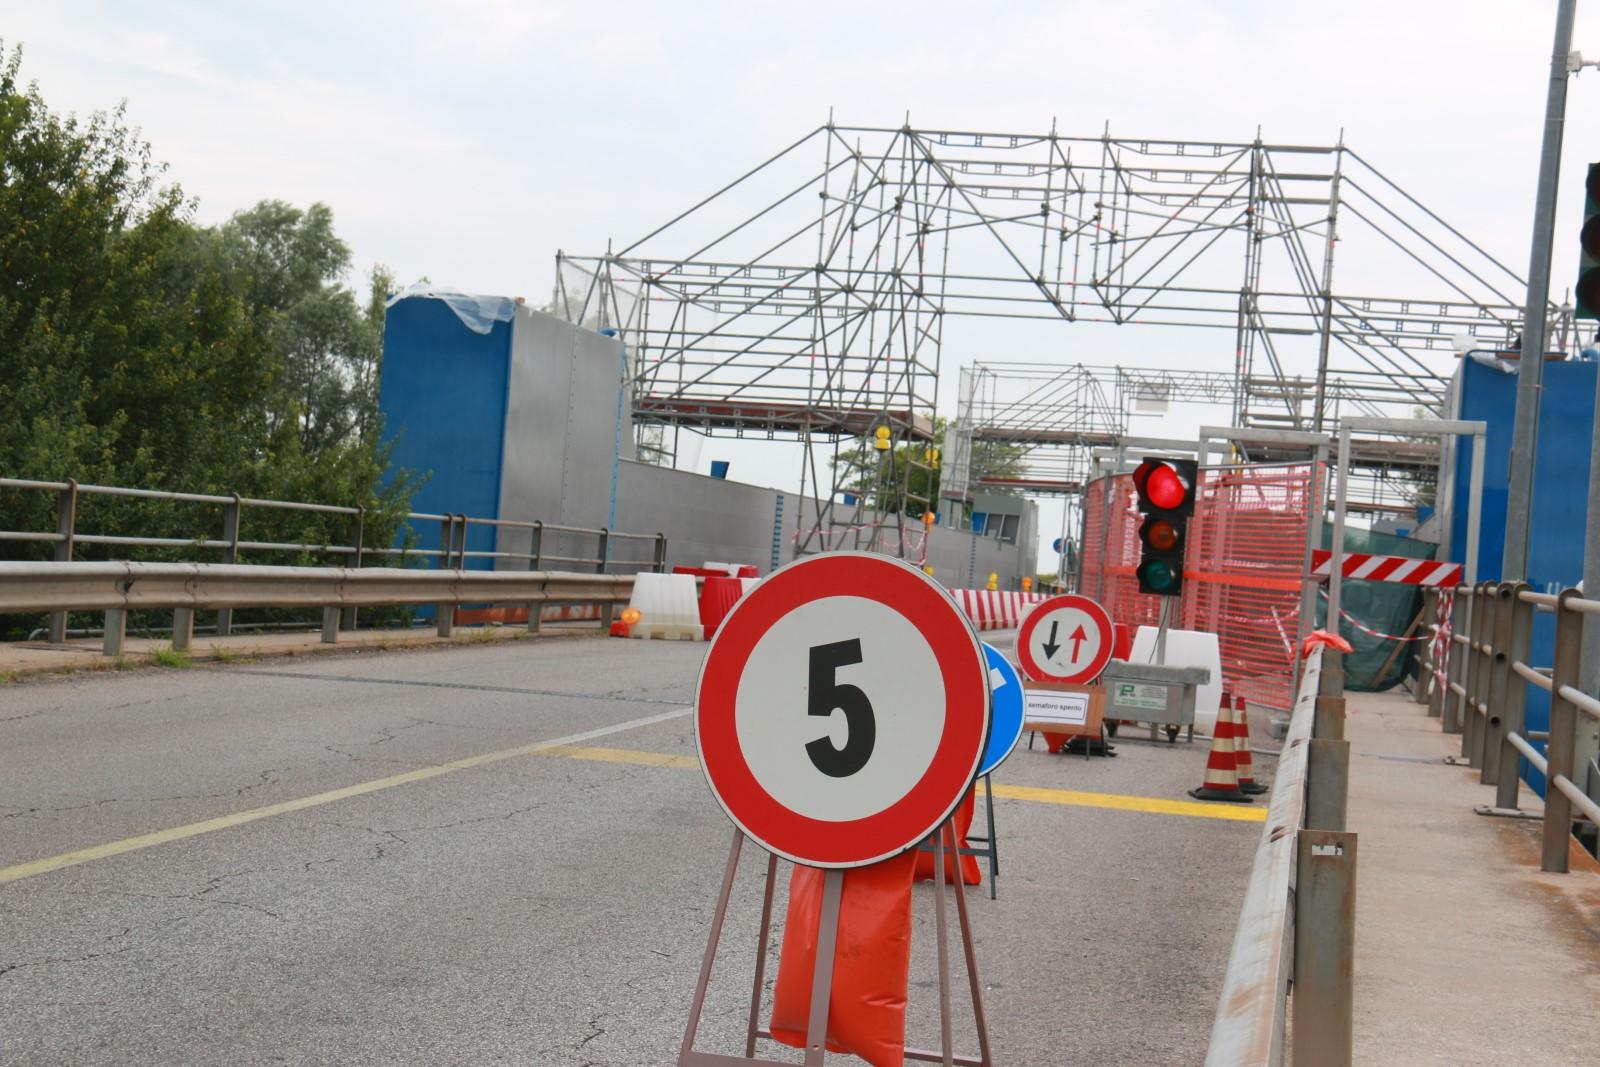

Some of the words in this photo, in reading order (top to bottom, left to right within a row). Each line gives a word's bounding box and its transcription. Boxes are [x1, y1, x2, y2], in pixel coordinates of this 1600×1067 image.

[805, 638, 876, 778] 5
[1028, 702, 1059, 710] semaforo
[1059, 704, 1082, 712] spento
